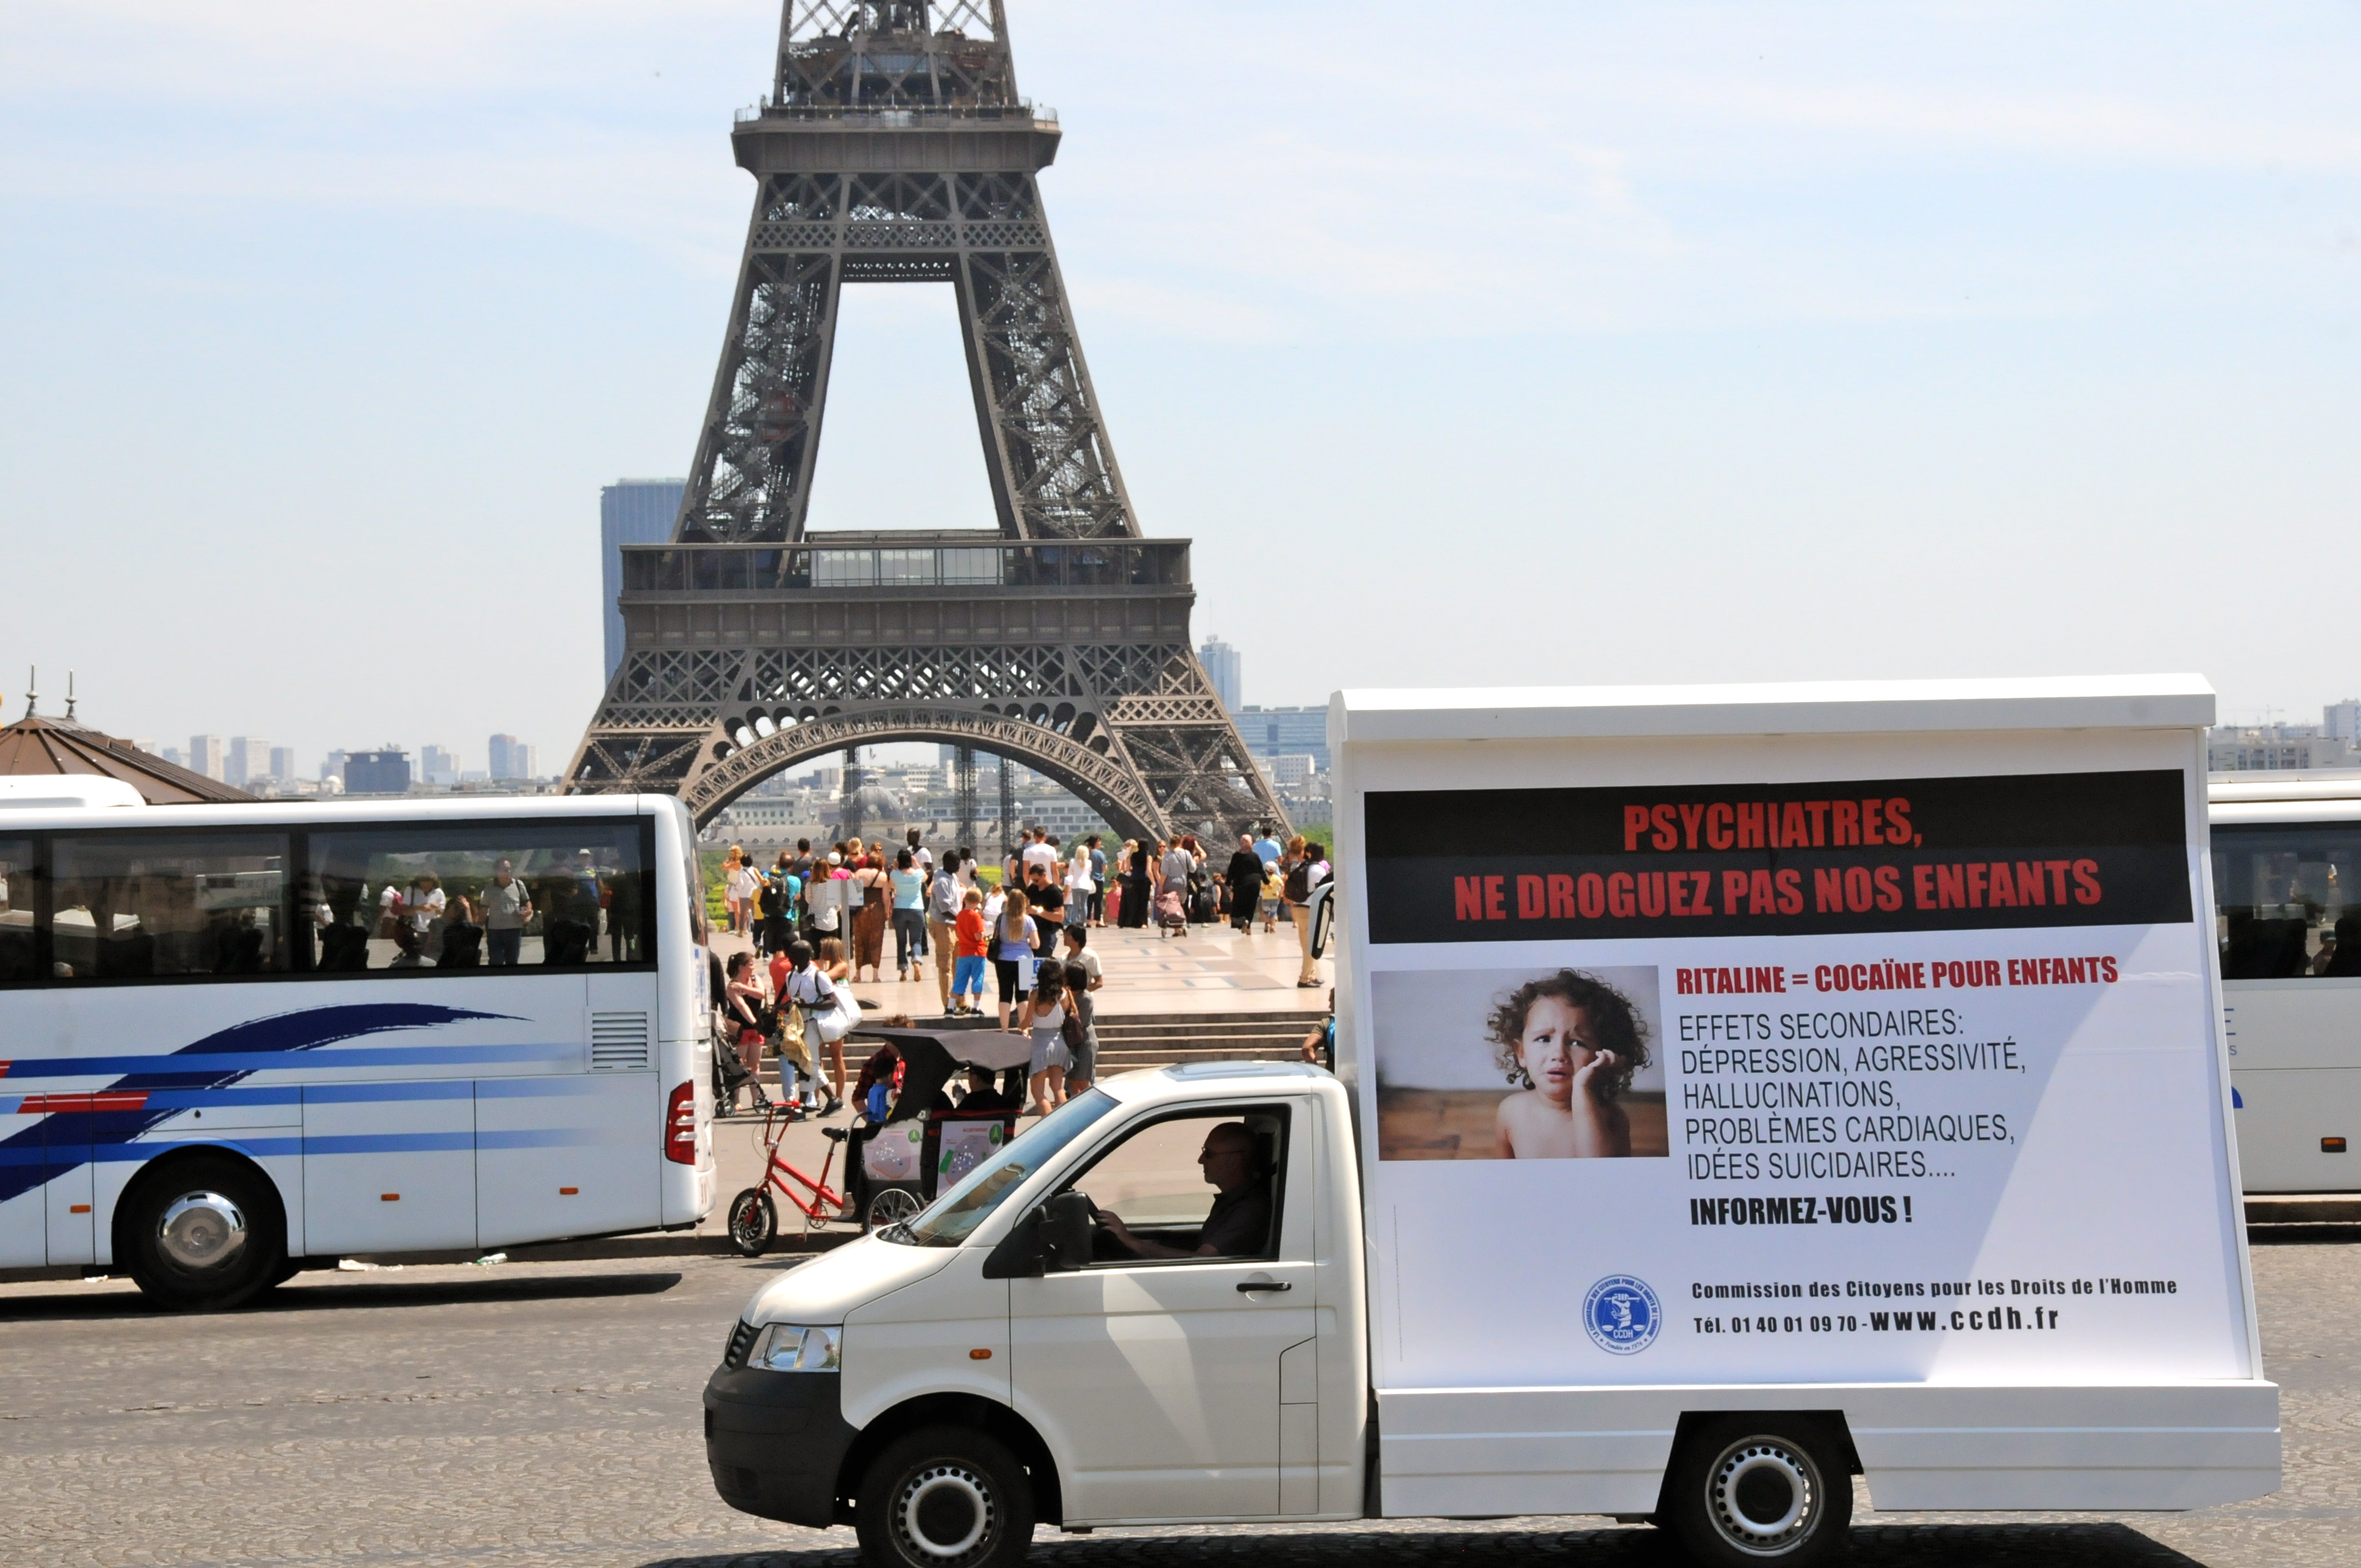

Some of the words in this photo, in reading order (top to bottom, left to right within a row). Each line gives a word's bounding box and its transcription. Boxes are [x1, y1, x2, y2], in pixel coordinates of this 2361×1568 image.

[1625, 798, 1922, 851] PSYCHIATRES,
[1456, 876, 1506, 920] NE
[1518, 872, 1713, 919] DROGUEZ
[1723, 870, 1804, 915] PAS
[1815, 867, 1903, 913] NOS
[1914, 860, 2102, 910] ENFANTS
[1678, 968, 1786, 994] RITALINE
[1792, 973, 1809, 986] =
[1816, 959, 1927, 992] COCAÏNE
[1933, 962, 2001, 987] POUR
[2009, 956, 2120, 986] ENFANTS
[1680, 1014, 1771, 1041] EFFETS
[1781, 1009, 1963, 1040] SECONDAIRES:
[1683, 1044, 1847, 1076] DÉPRESSION,
[1855, 1035, 2026, 1074] AGRESSIVITÉ,
[1685, 1081, 1900, 1111] HALLUCINATIONS,
[1687, 1112, 1837, 1145] PROBLÈMES
[1846, 1115, 2014, 1145] CARDIAQUES,
[1689, 1148, 1760, 1180] IDÉES
[1691, 1196, 1897, 1226] INFORMEZ-VOUS
[1903, 1196, 1912, 1223] !
[1591, 1289, 1600, 1299] DES
[1598, 1278, 1620, 1291] CITOYENS
[1635, 1283, 1645, 1291] LES
[1693, 1282, 1803, 1299] Commission
[1810, 1282, 1841, 1298] des
[1847, 1281, 1925, 1298] Citoyens
[1932, 1283, 1972, 1298] pour
[1978, 1280, 2005, 1295] les
[2011, 1280, 2066, 1295] Droits
[2072, 1280, 2093, 1295] de
[2100, 1279, 2177, 1294] l'Homme
[1613, 1330, 1634, 1338] CCDH
[1694, 1317, 1726, 1333] Tél.
[1732, 1317, 1750, 1333] 01
[1757, 1317, 1777, 1333] 40
[1785, 1317, 1803, 1333] 01
[1811, 1316, 1832, 1332] 09
[1838, 1316, 1857, 1332] 70
